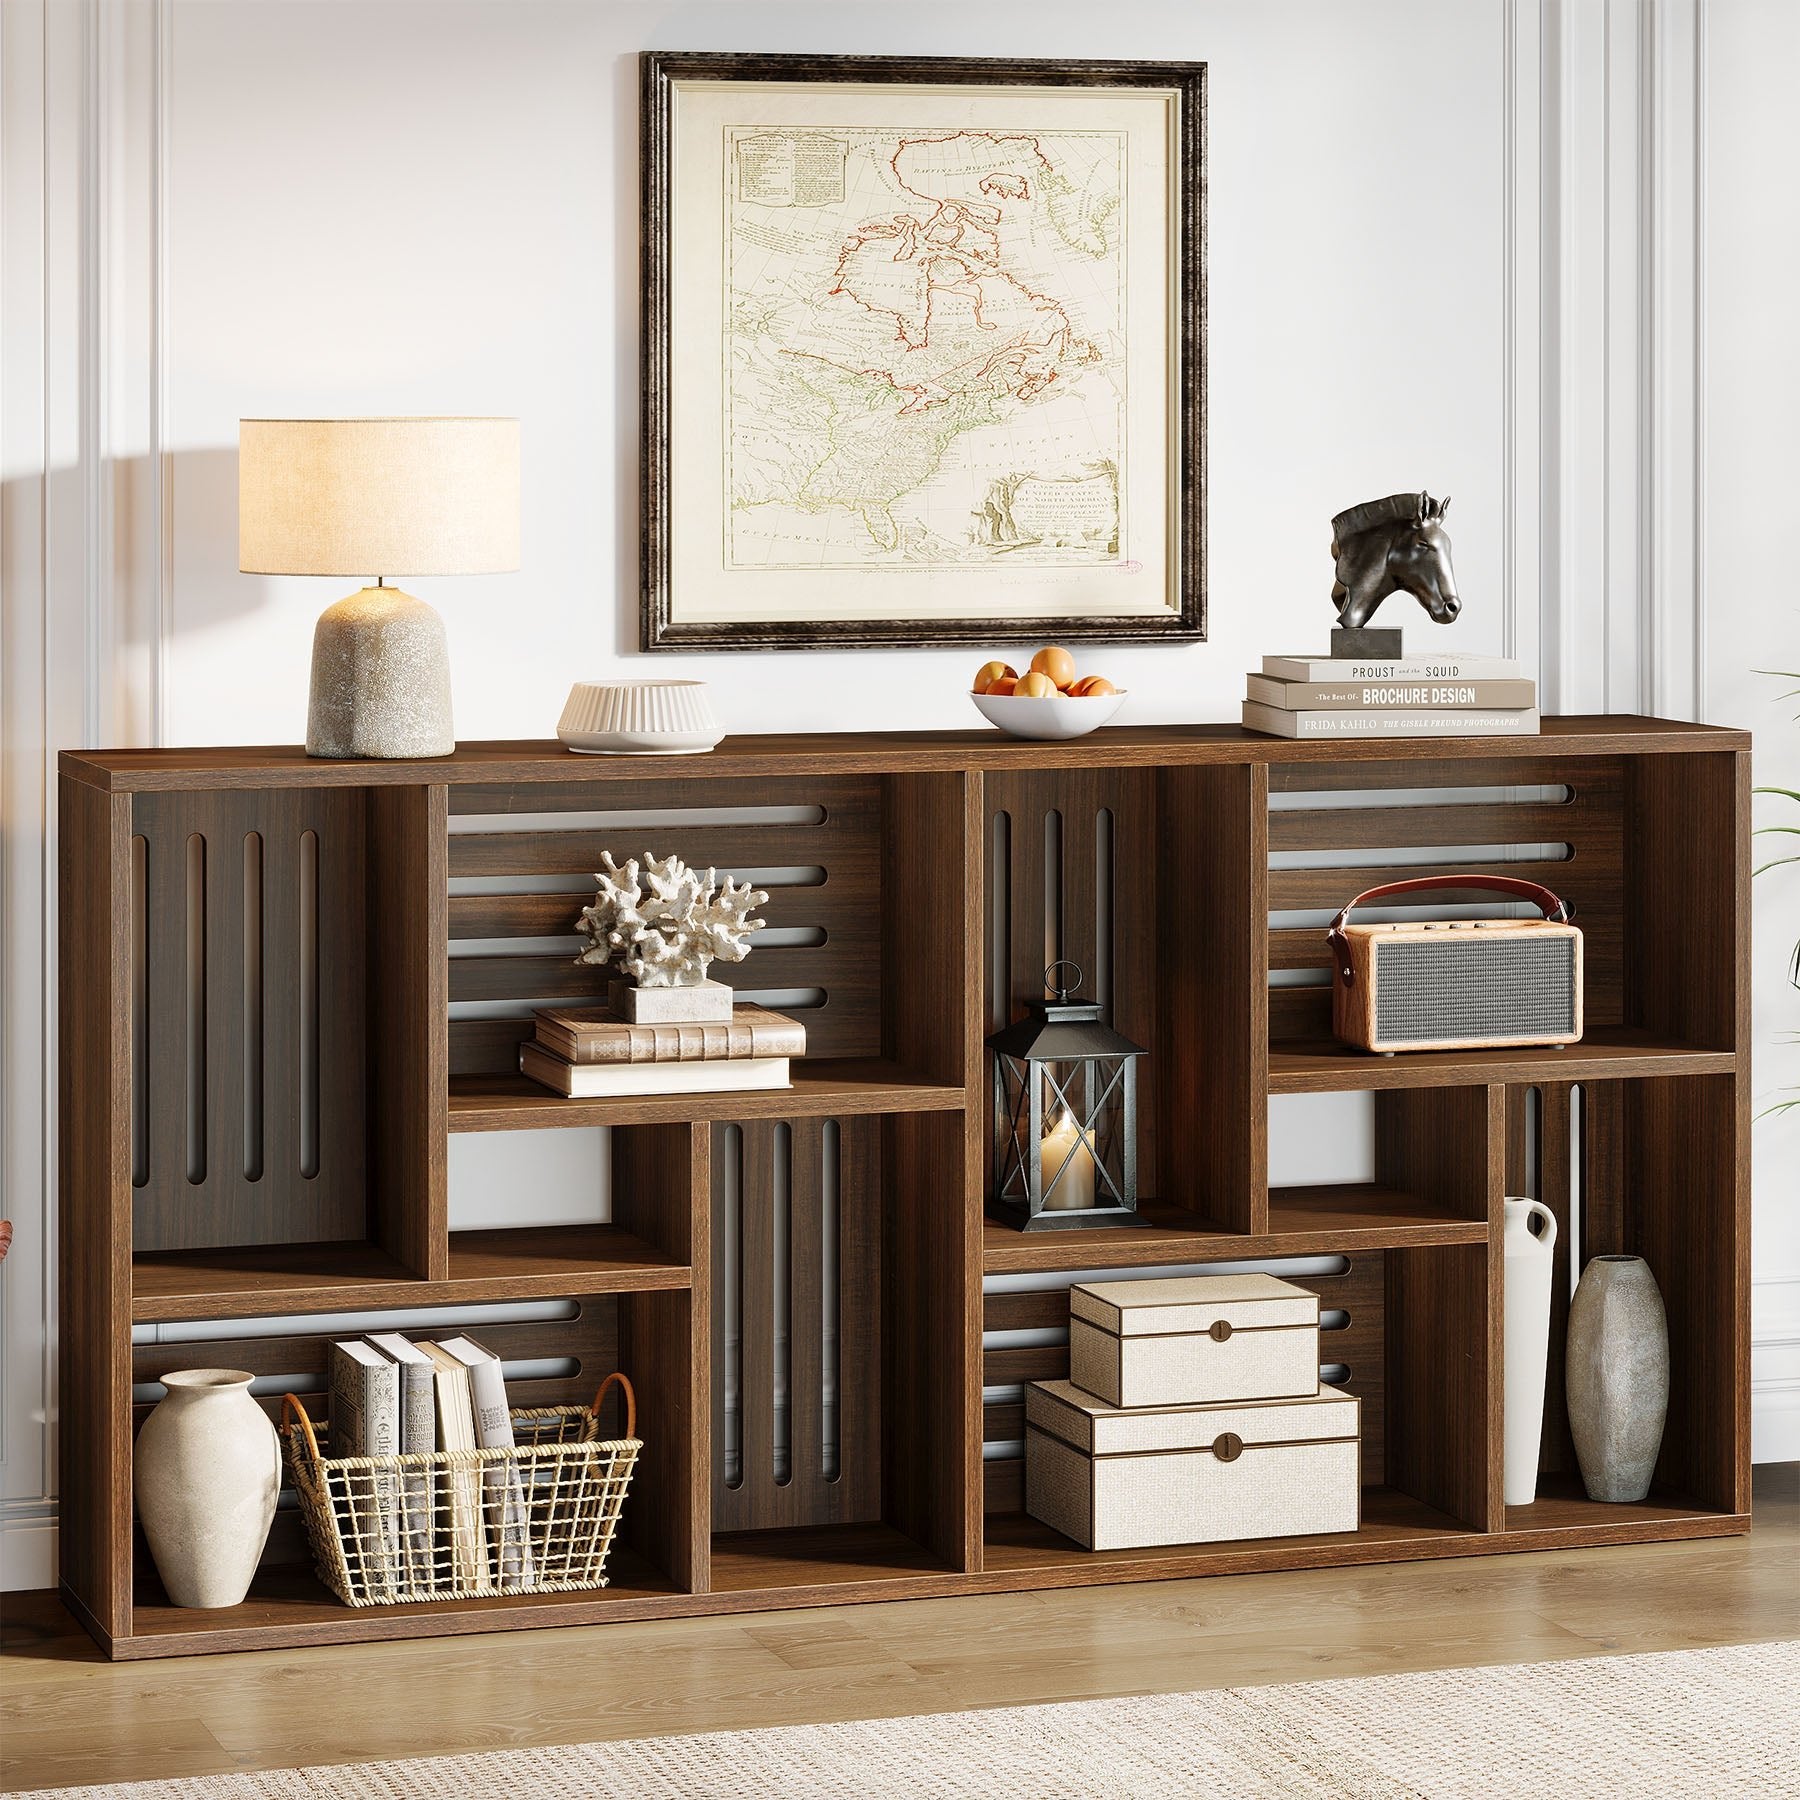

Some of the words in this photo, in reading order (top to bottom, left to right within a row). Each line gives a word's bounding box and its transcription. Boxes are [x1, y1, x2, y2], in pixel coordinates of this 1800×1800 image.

[1352, 666, 1395, 678] PROUST
[1425, 666, 1459, 677] SQUID
[1332, 693, 1346, 701] Best
[1362, 687, 1429, 704] BROCHURE
[1431, 687, 1476, 704] DESIGN
[1305, 720, 1337, 730] FRIDA
[1339, 719, 1377, 730] KAHLO
[1383, 720, 1399, 728] THE
[1400, 720, 1429, 728] GISELE
[1430, 719, 1461, 728] FREUND
[1463, 718, 1519, 727] PHOTOGRAPHS
